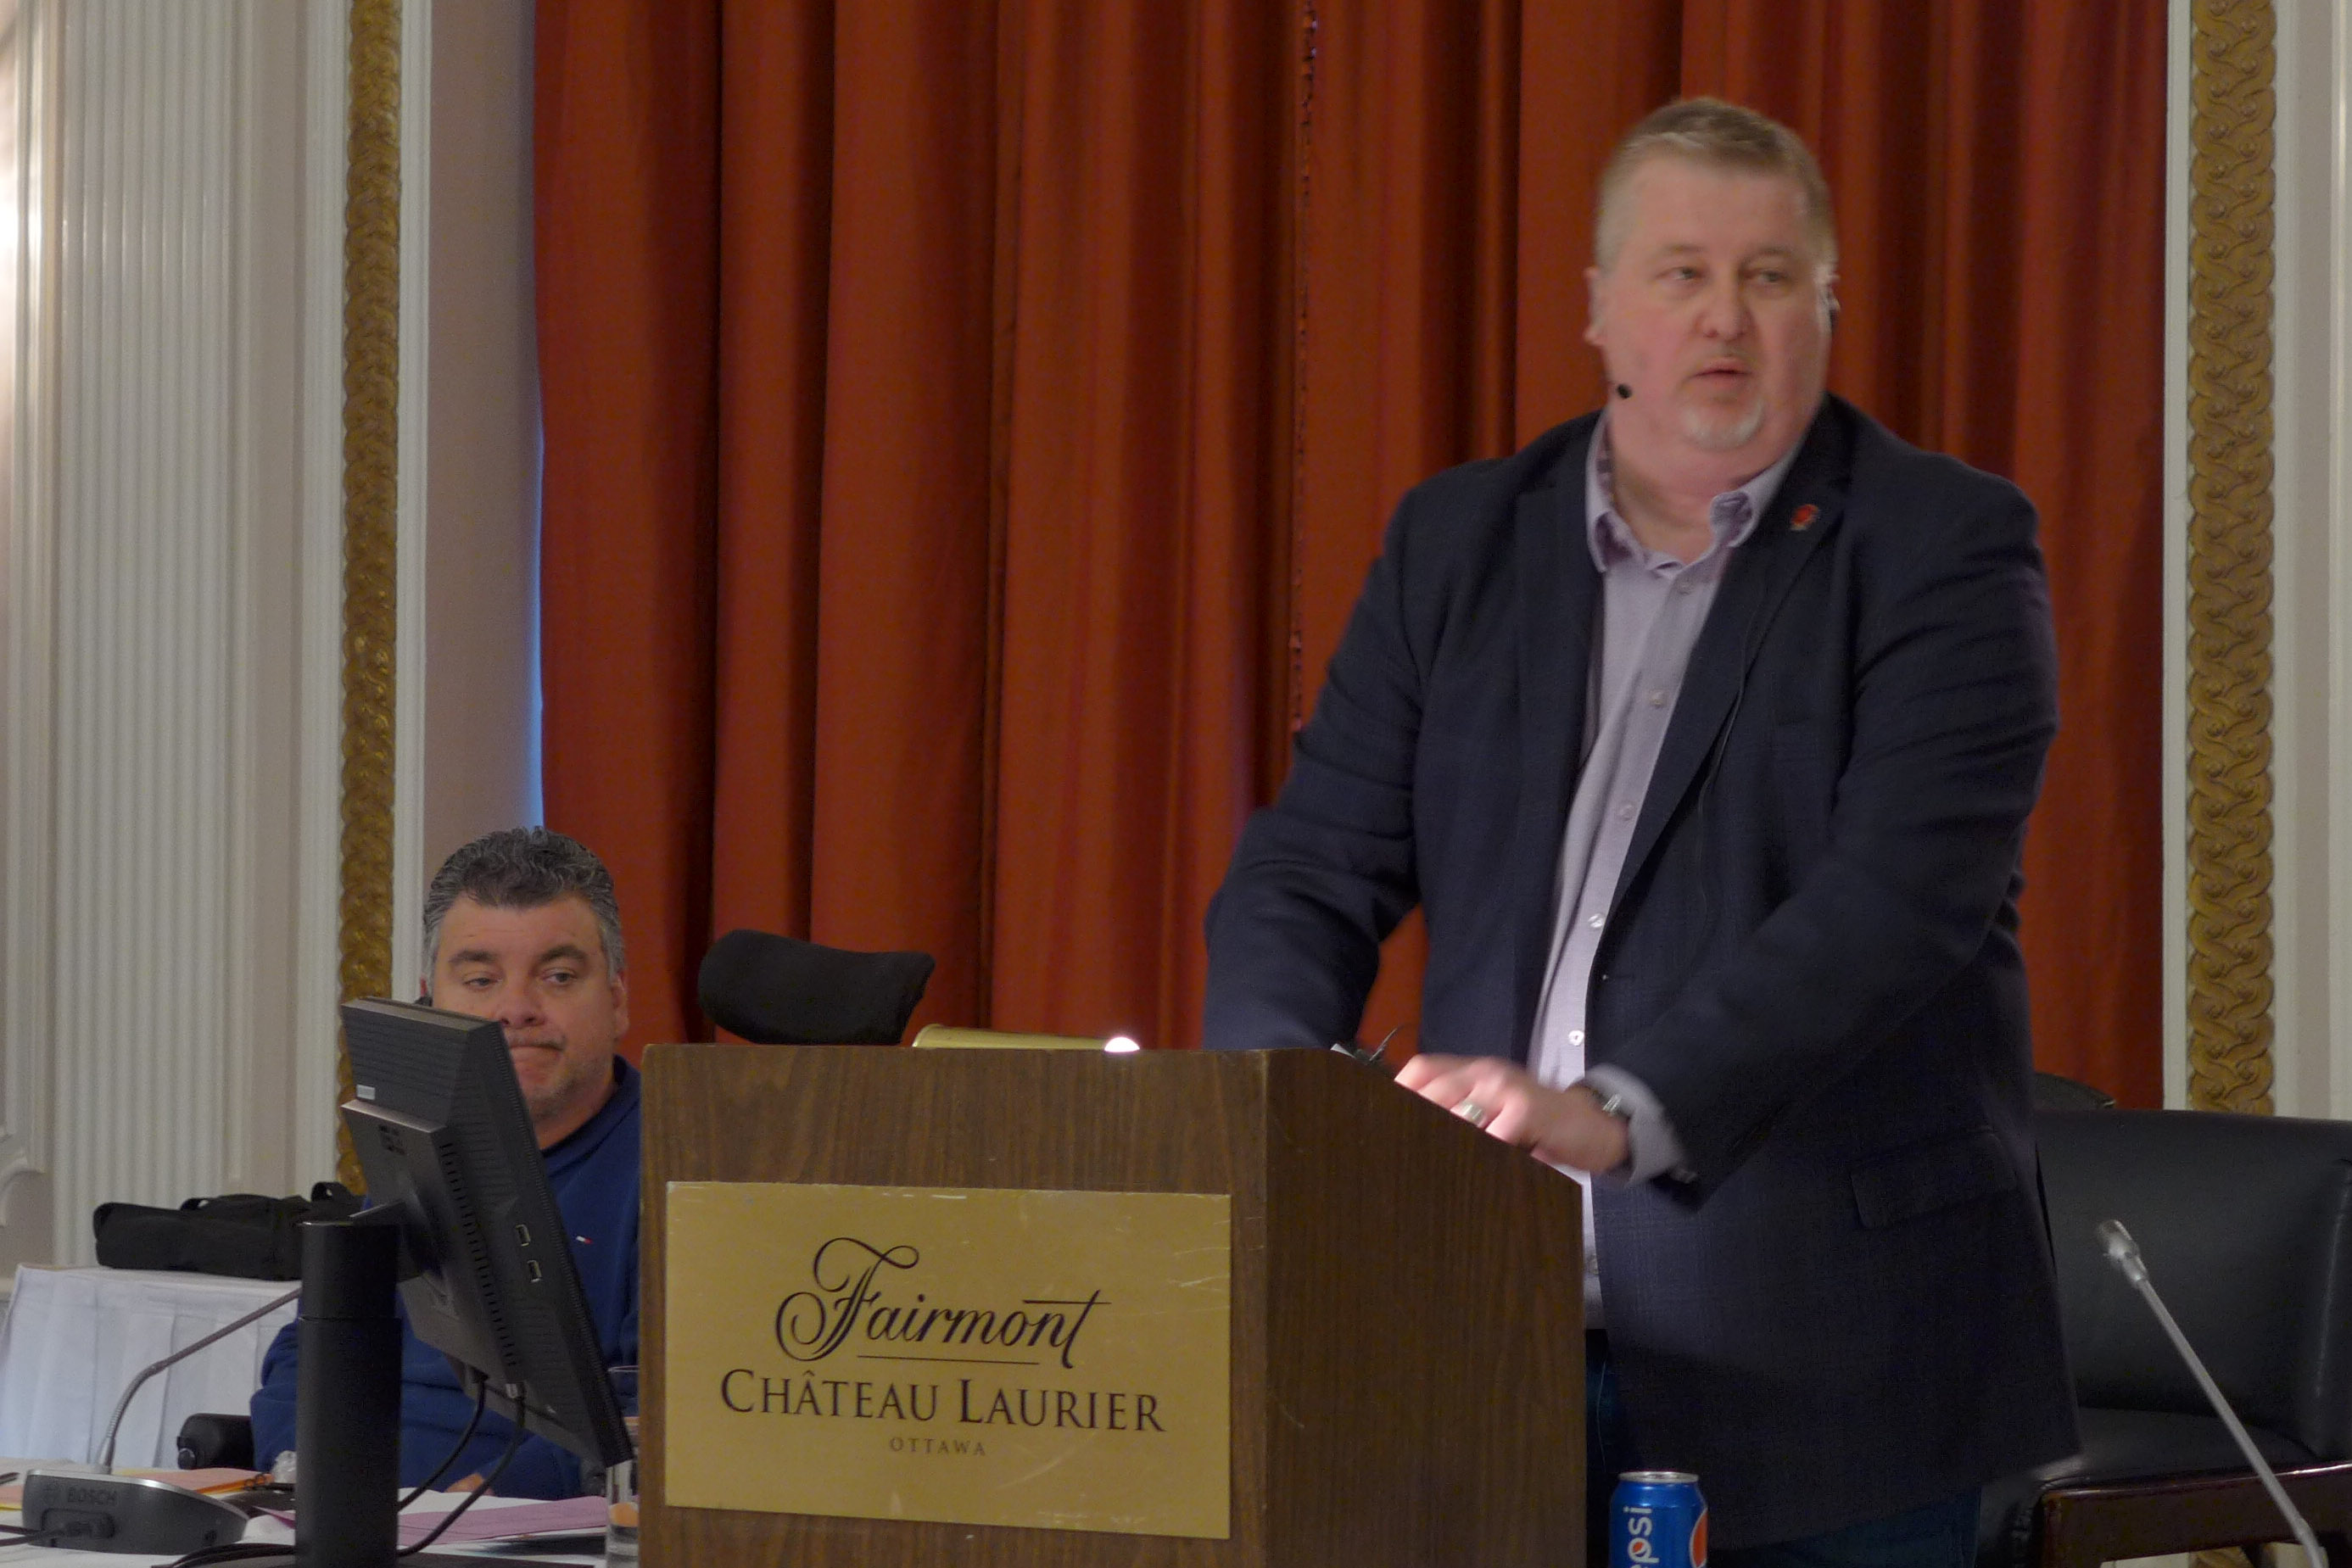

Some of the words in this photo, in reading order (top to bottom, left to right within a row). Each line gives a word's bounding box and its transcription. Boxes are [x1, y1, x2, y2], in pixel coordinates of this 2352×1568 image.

[776, 1237, 1111, 1369] Fairmont
[720, 1369, 937, 1422] CHÂTEAU
[958, 1378, 1165, 1432] LAURIER
[889, 1437, 986, 1457] OTTAWA
[67, 1487, 117, 1506] BOSCH
[1623, 1506, 1659, 1568] psi
